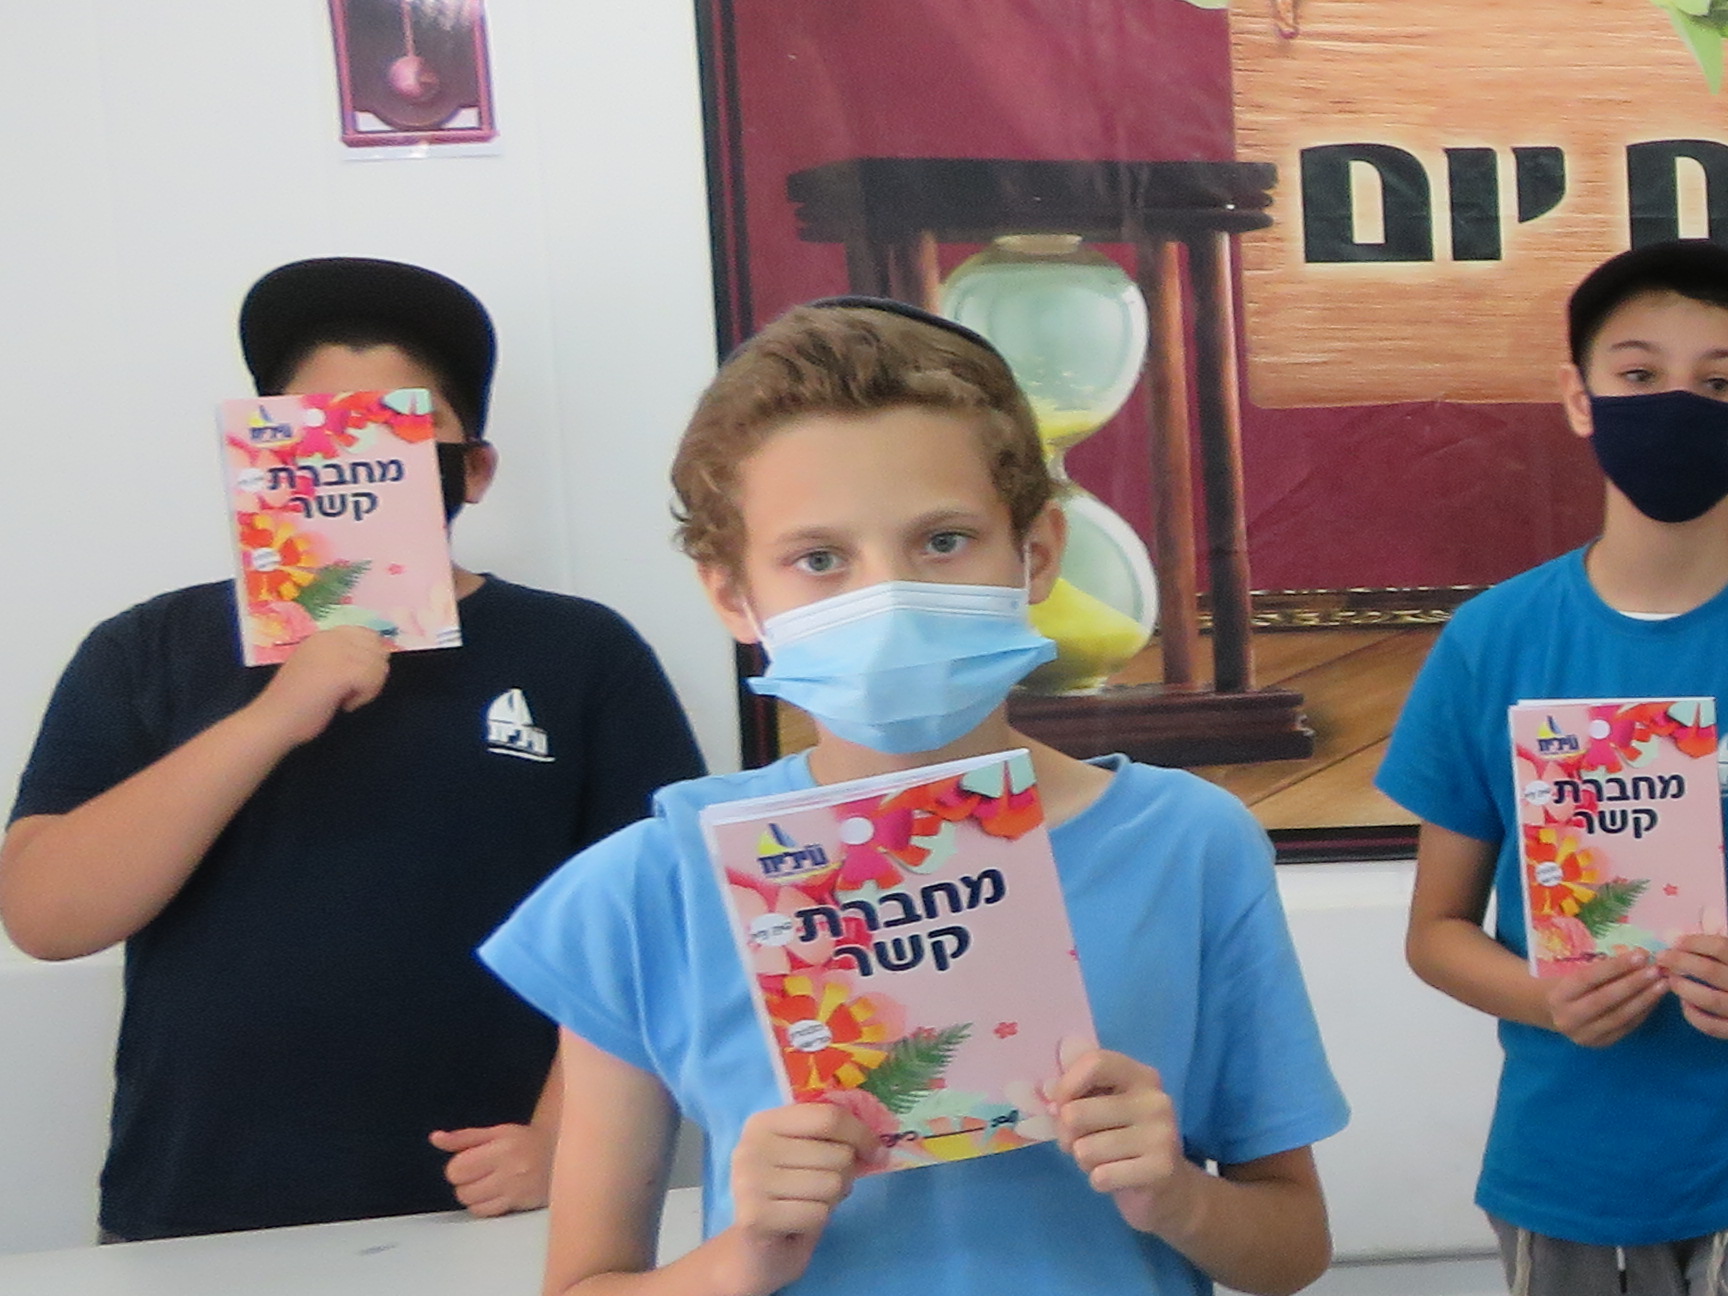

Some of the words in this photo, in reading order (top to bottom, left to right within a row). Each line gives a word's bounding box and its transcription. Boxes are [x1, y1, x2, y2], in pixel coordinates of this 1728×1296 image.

[1299, 144, 1567, 264] יום
[268, 459, 404, 491] מחברת
[290, 492, 378, 522] קשר
[1553, 774, 1685, 805] מחברת
[1573, 808, 1658, 839] קשר
[794, 868, 1006, 943] מחברת
[833, 925, 971, 977] קשר
